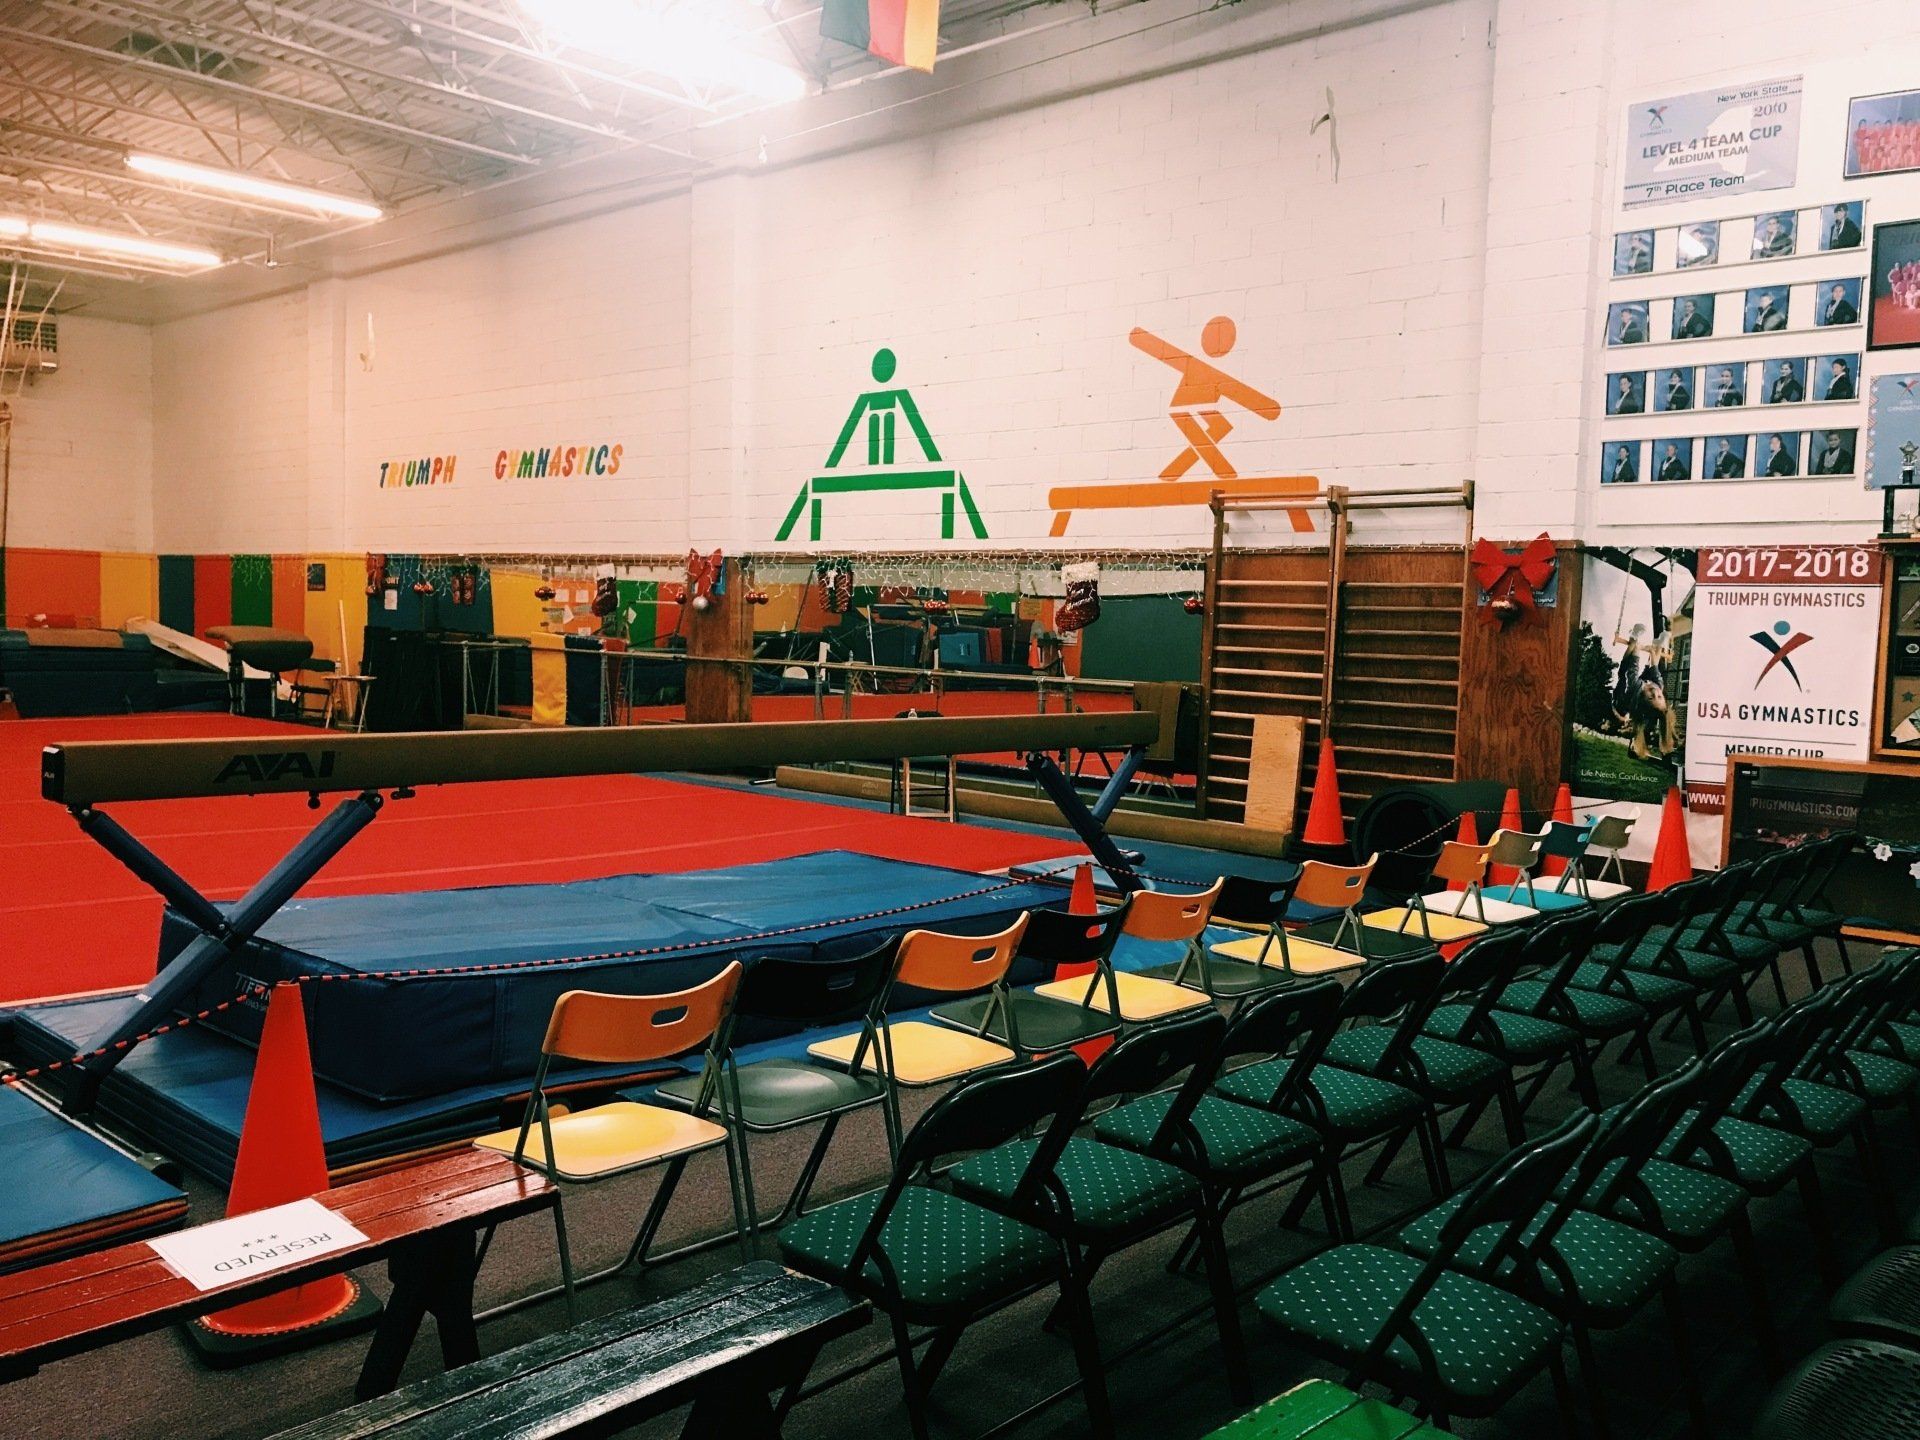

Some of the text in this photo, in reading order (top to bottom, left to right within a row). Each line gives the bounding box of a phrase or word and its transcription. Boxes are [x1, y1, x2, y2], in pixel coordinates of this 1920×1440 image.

[1717, 85, 1788, 103] New York State
[1753, 102, 1788, 117] 2010
[1642, 124, 1783, 158] LEVEL 4 TEAM CUP
[1668, 145, 1750, 166] MEDIUM TEAM
[1665, 180, 1705, 194] Place
[1708, 175, 1745, 188] Team
[379, 443, 624, 489] TRIUMPH GYMNASTICS
[1706, 551, 1870, 577] 2017-2018
[1708, 591, 1866, 607] TRIUMPH GYMNASTICS
[1697, 702, 1859, 727] USA GYMNASTICS
[1580, 769, 1593, 777] Life
[1618, 772, 1659, 782] Confidence
[214, 1232, 333, 1273] RESERVED
